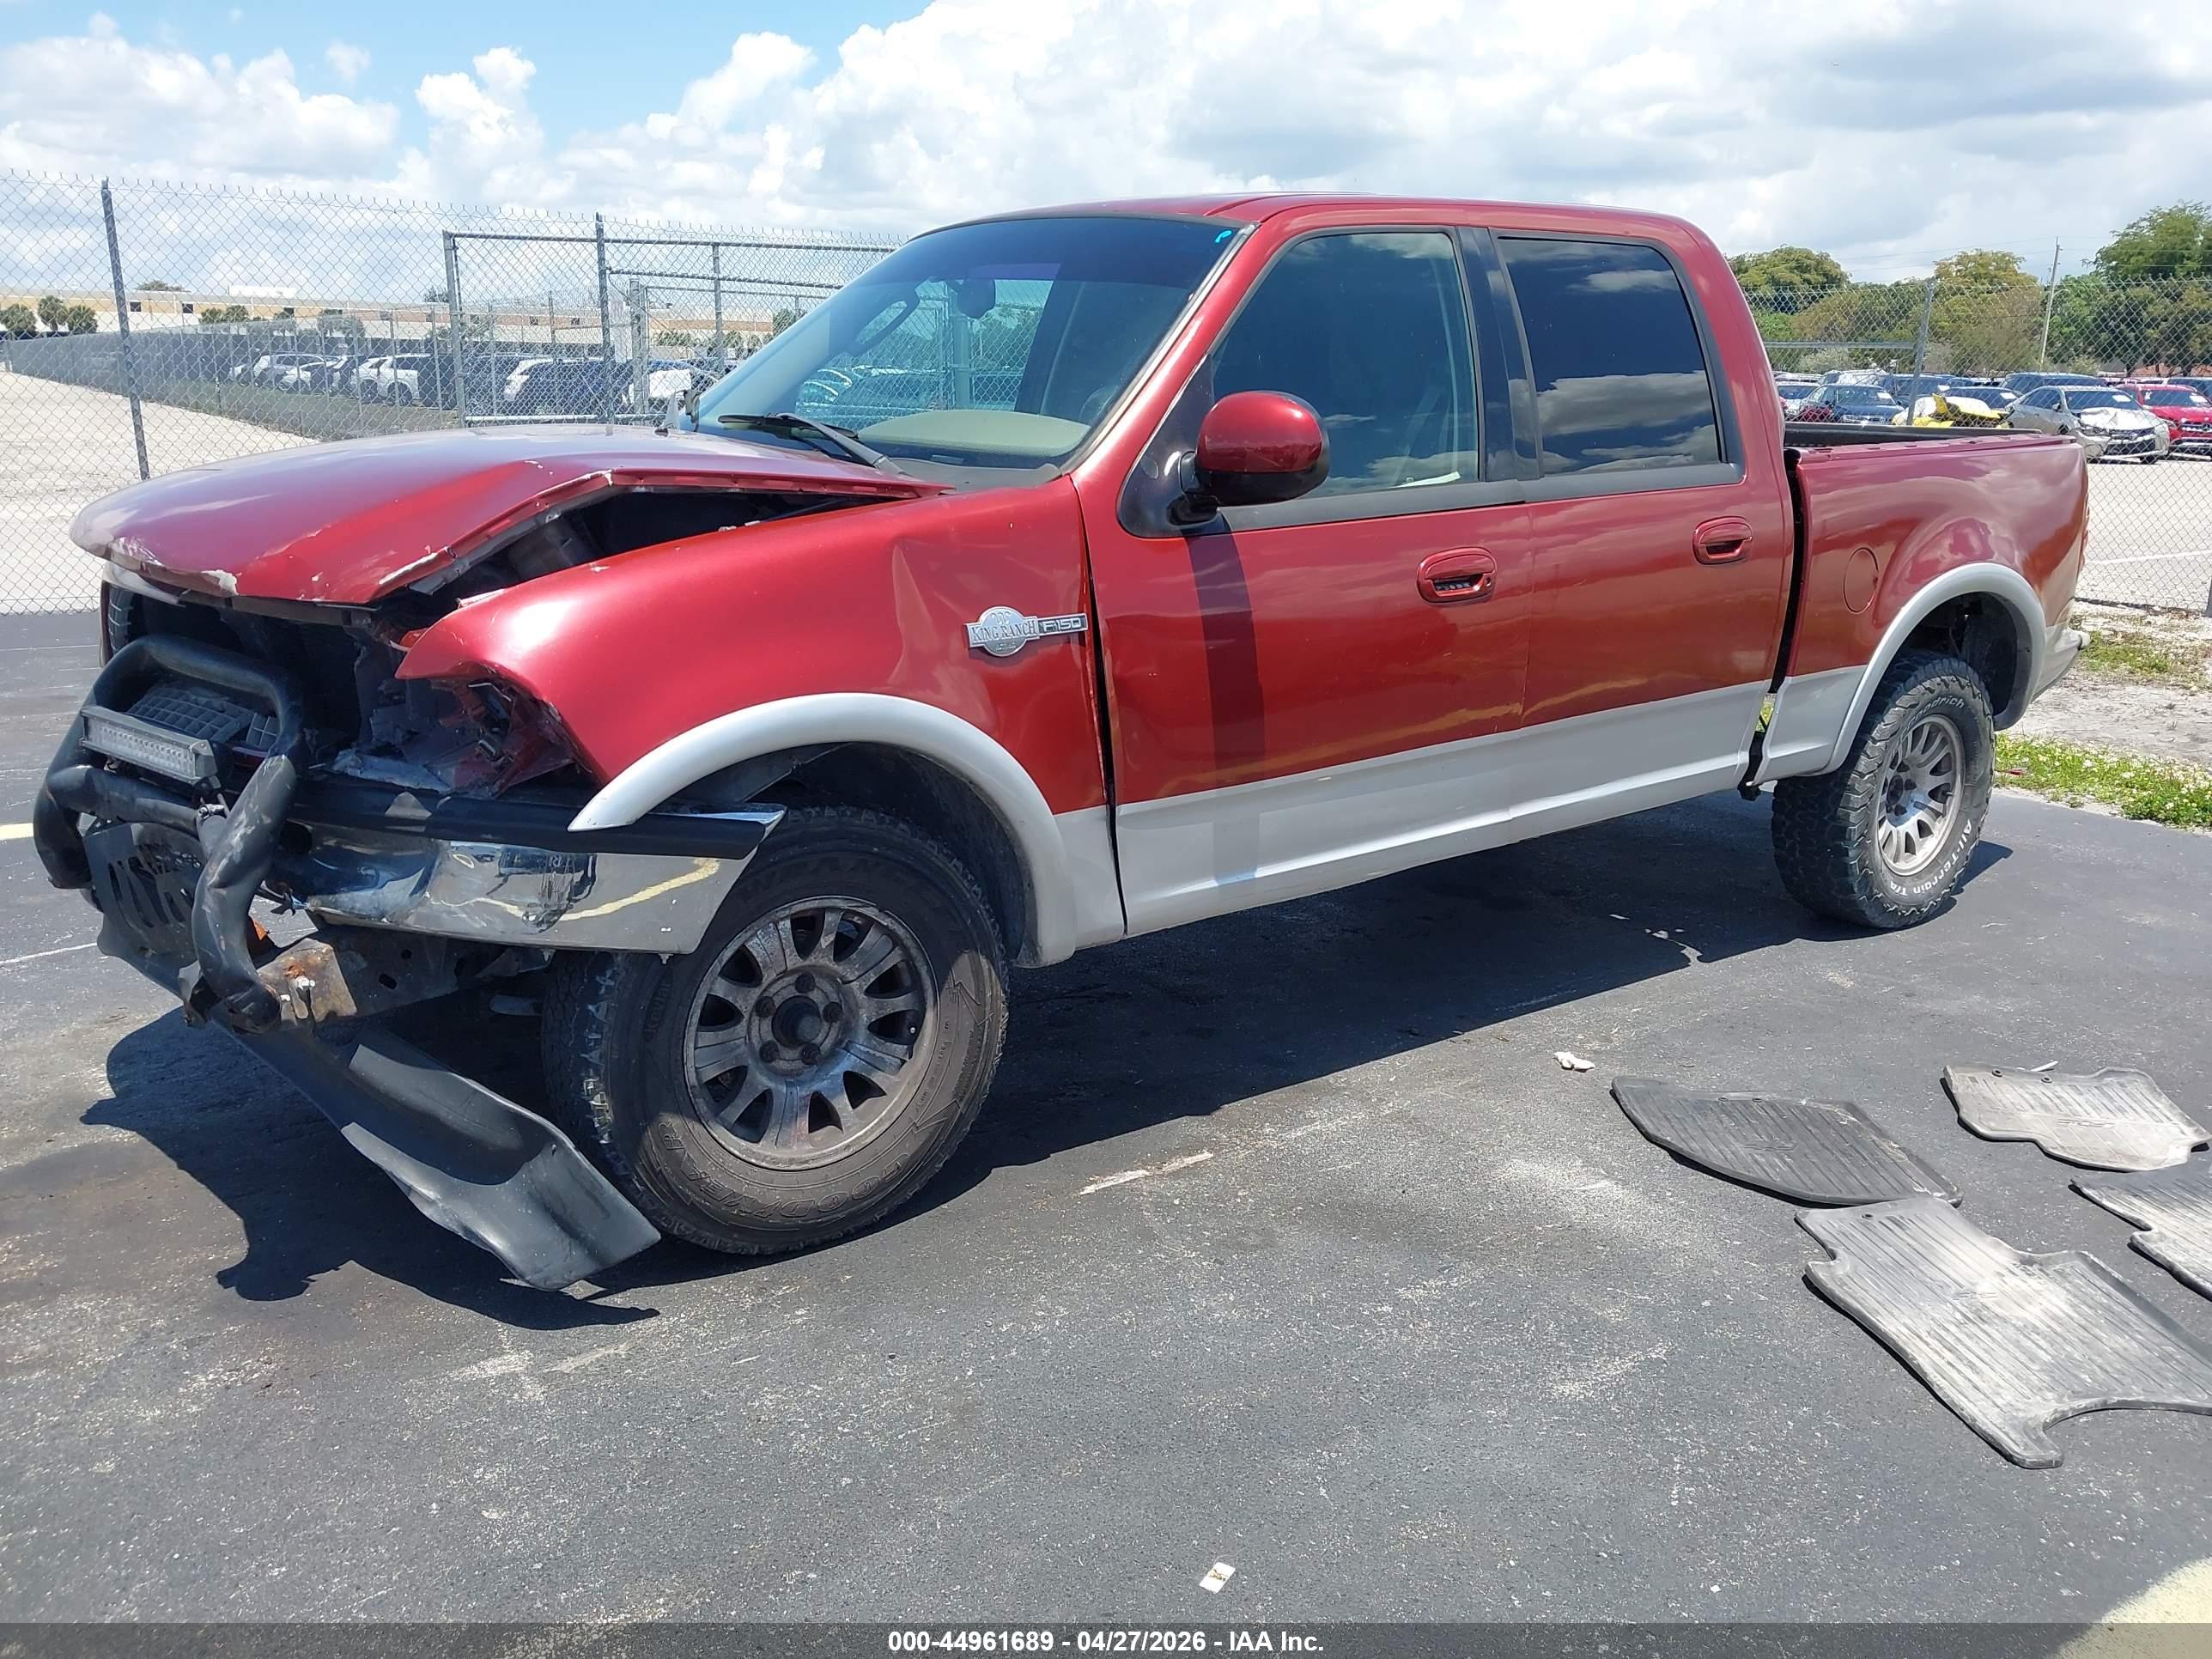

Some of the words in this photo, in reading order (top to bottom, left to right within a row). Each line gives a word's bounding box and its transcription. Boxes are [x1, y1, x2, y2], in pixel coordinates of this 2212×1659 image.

[1000, 620, 1039, 638] RANCH
[1901, 696, 1966, 735] Goodrich
[1913, 818, 1972, 894] All-Terrain
[658, 1121, 910, 1218] GOODYEAR
